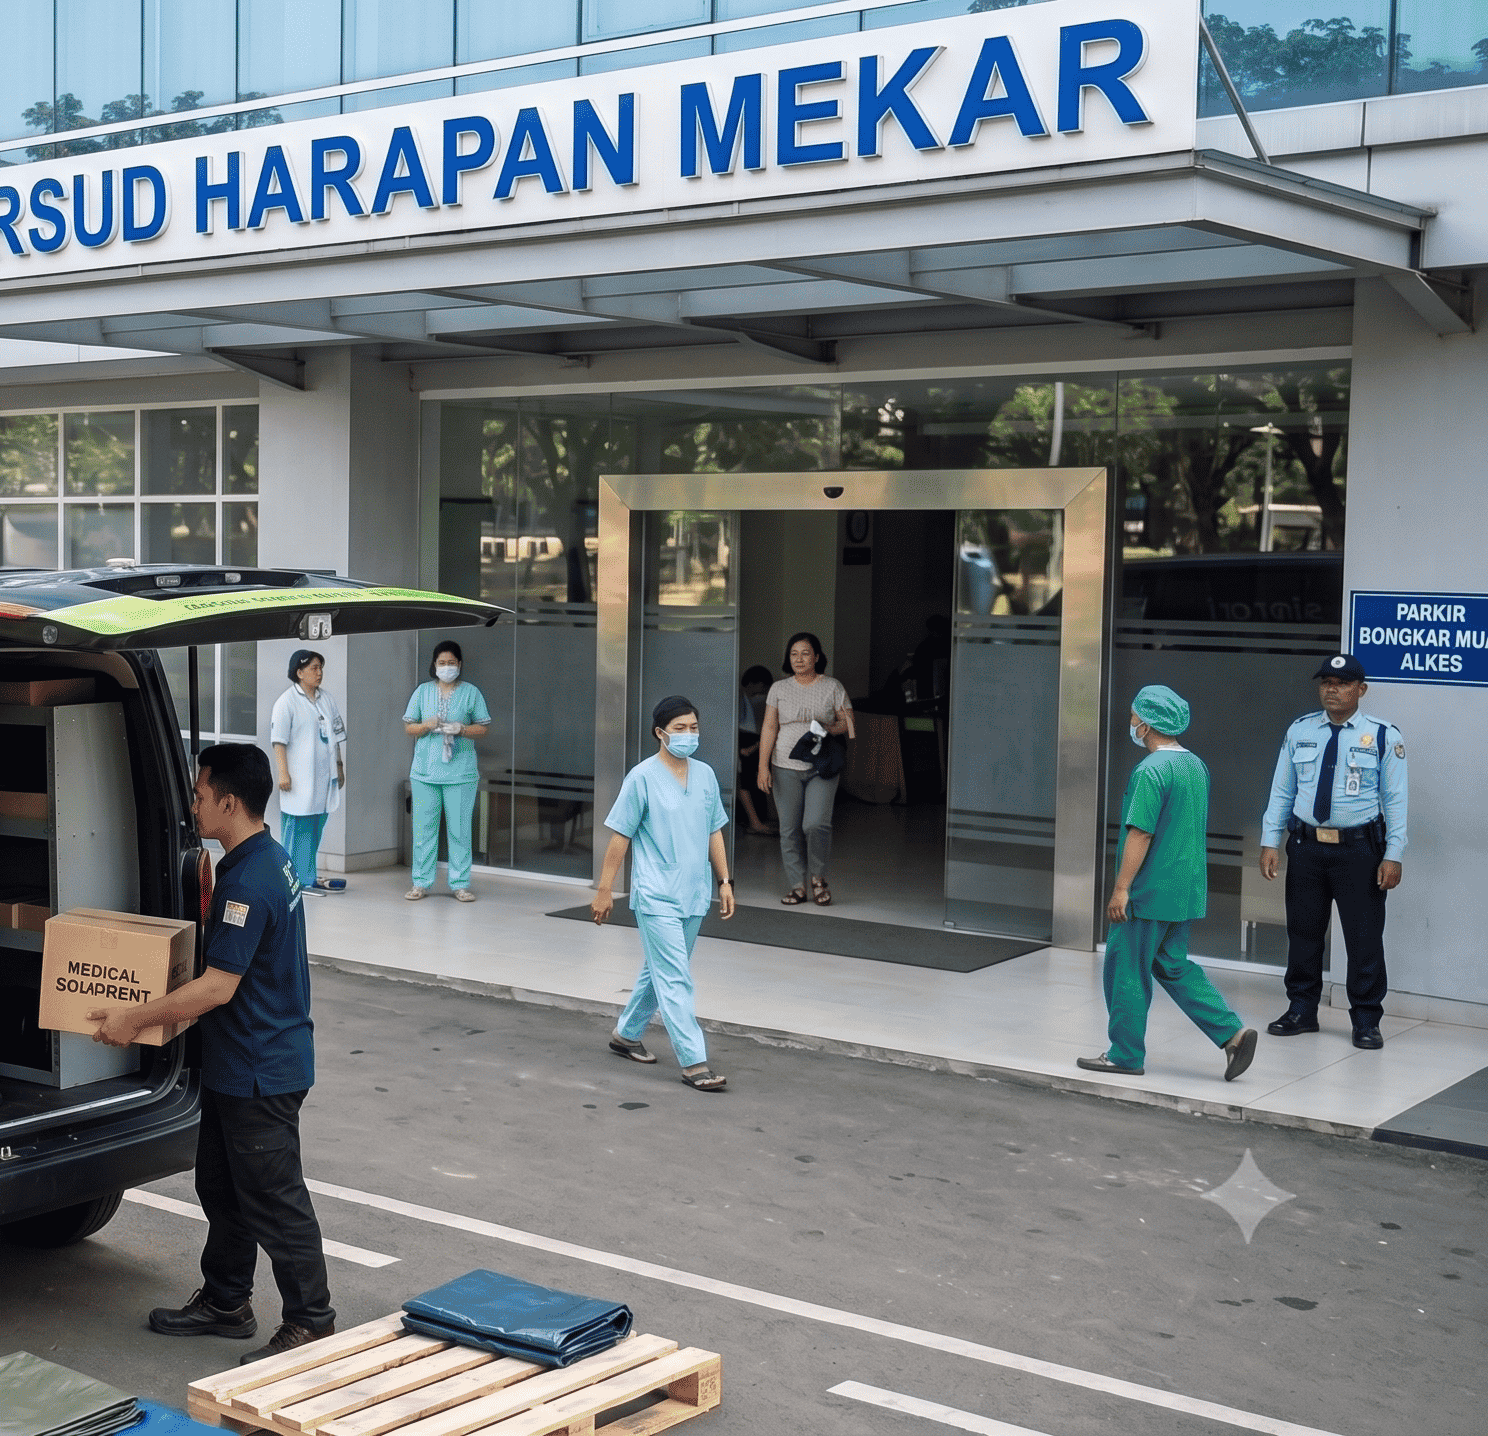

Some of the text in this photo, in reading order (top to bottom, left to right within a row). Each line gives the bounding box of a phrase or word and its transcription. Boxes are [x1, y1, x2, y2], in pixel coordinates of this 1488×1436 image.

[194, 93, 640, 235] HARAPAN
[680, 18, 1154, 180] MEKAR
[1396, 602, 1466, 623] PARKIR
[1359, 626, 1488, 649] BONGKAR MU
[1400, 652, 1463, 673] ALKES
[67, 960, 140, 984] MEDICAL
